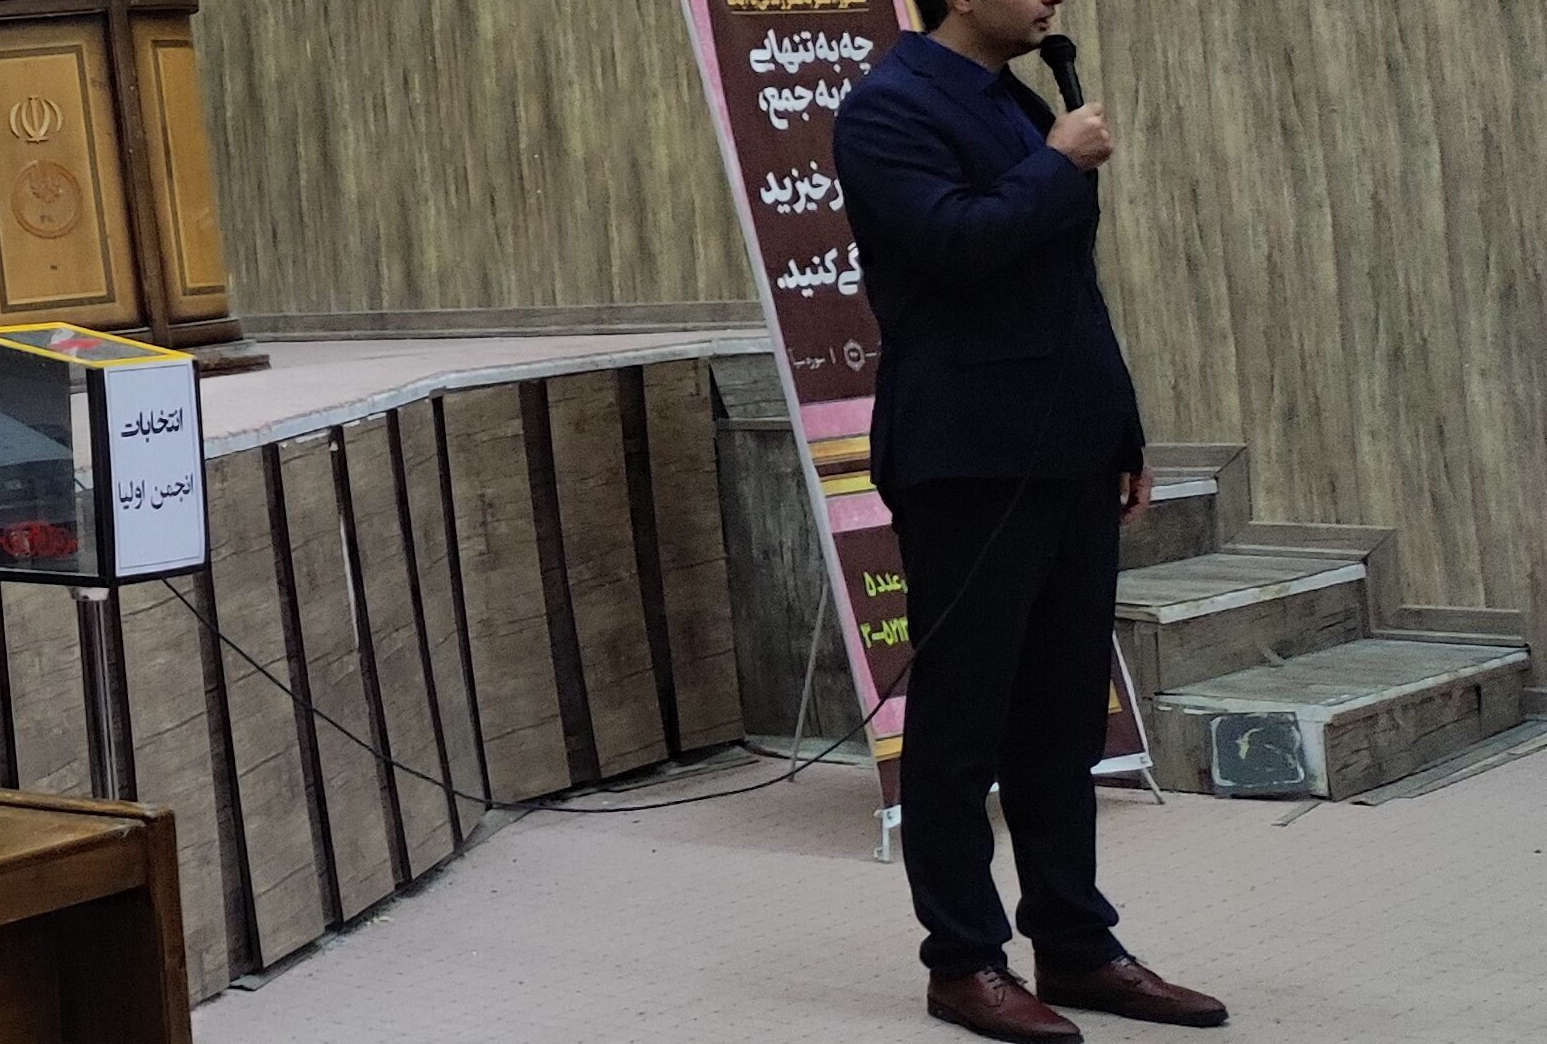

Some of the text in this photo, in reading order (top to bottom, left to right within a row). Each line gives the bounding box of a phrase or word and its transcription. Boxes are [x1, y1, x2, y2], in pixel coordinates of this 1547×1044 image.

[815, 31, 840, 74] به
[815, 78, 842, 118] به
[759, 160, 845, 214] رخیزید
[120, 407, 183, 443] انتخابات
[118, 472, 194, 510] انجمن اولیا
